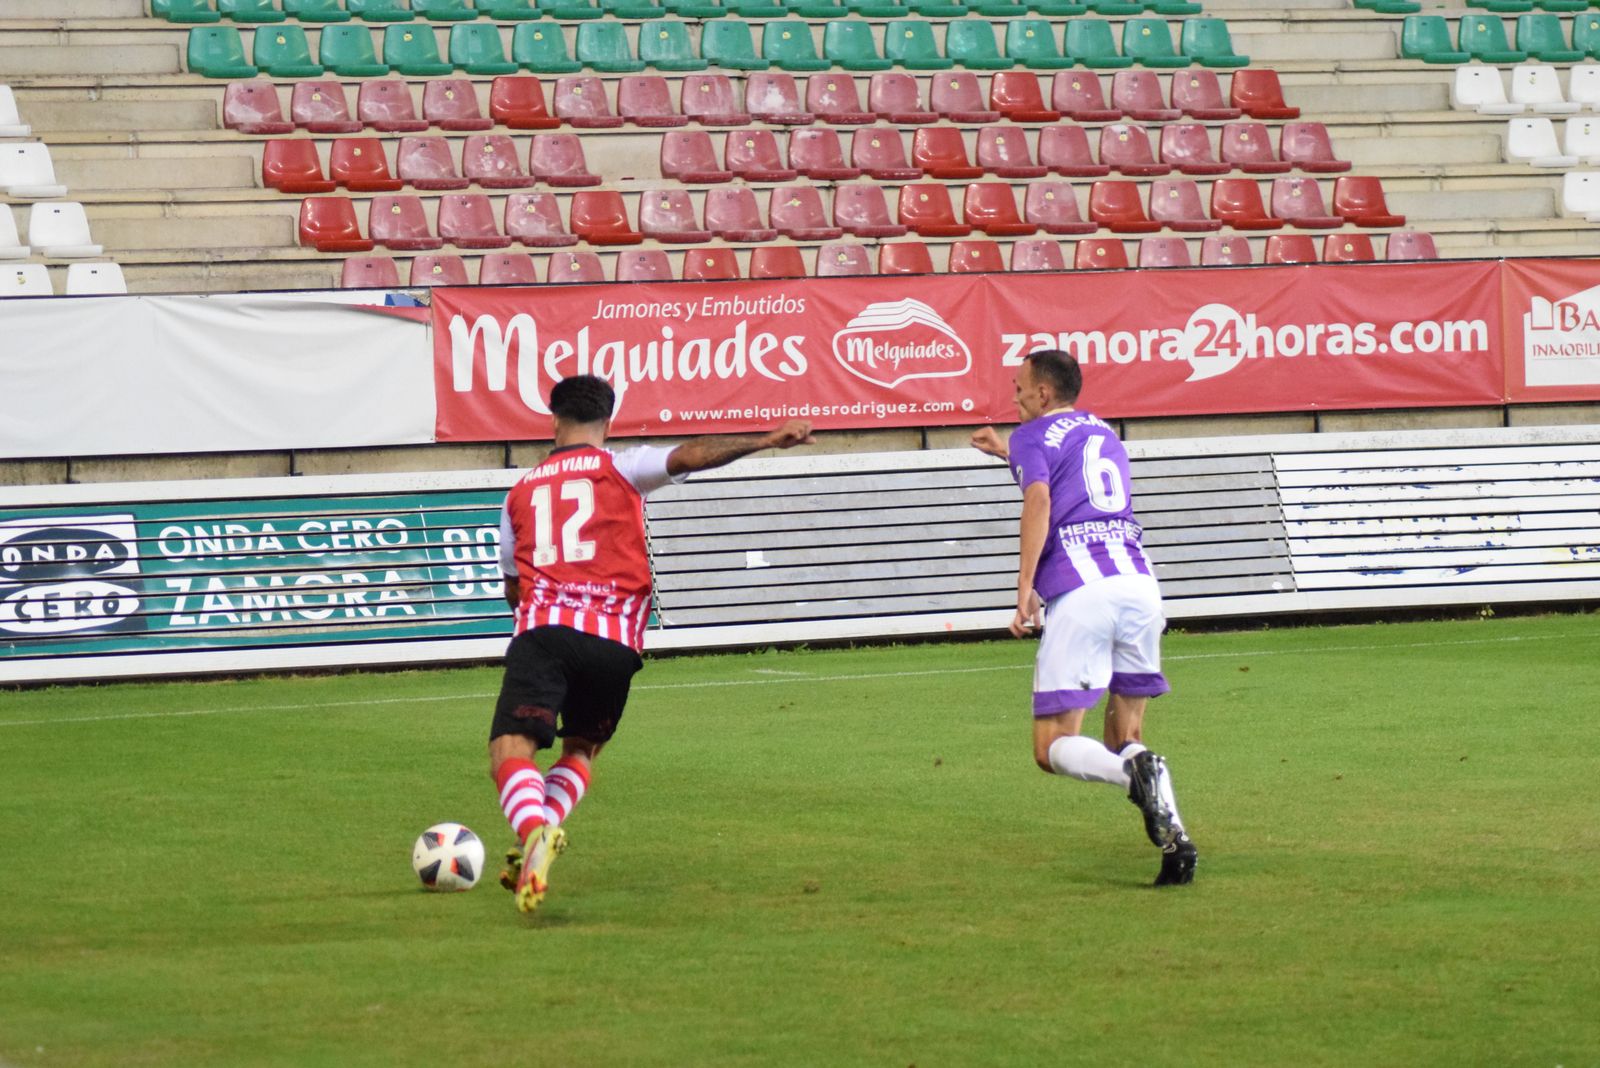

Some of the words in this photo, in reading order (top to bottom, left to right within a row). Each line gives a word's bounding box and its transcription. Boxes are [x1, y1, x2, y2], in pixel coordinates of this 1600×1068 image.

[591, 300, 681, 320] Jamones
[684, 302, 697, 322] y
[701, 294, 805, 317] Embutidos
[449, 313, 808, 421] Melquiades
[846, 337, 956, 371] Melquiades
[679, 401, 955, 421] www.melquiadesrodriguez.com
[562, 455, 600, 473] VIANA
[1083, 435, 1127, 512] 6
[530, 479, 595, 567] 12
[157, 522, 286, 563] ONDA
[297, 518, 409, 557] CERO
[3, 544, 116, 572] ONDA
[14, 591, 120, 624] CERO
[165, 570, 417, 626] ZAMORA
